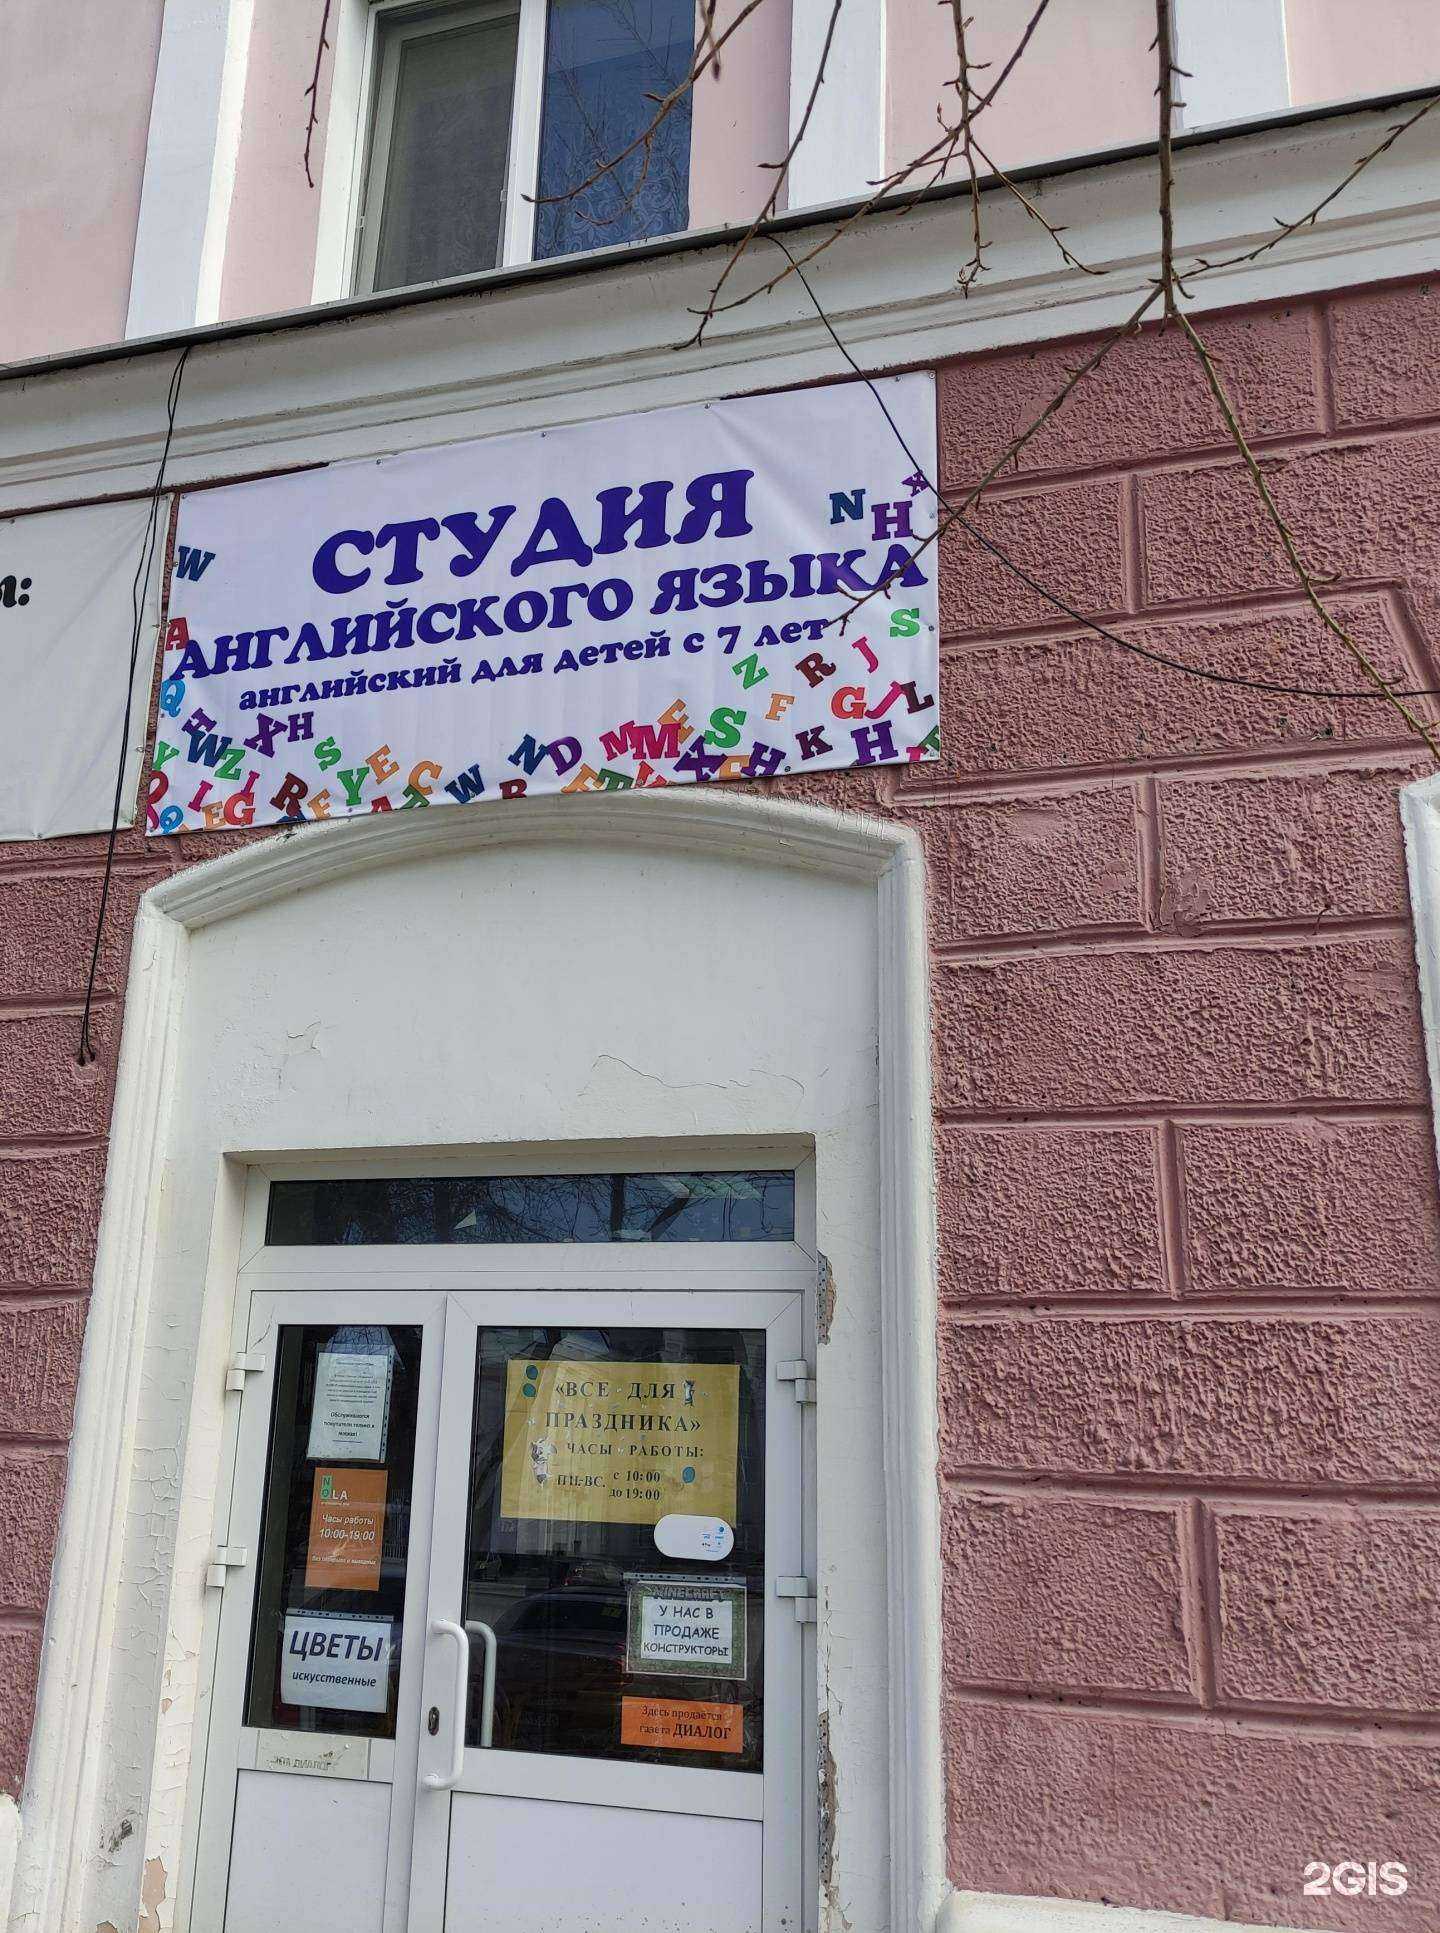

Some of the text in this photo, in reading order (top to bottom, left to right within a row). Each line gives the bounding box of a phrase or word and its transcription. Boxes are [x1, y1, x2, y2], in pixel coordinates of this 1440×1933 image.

[312, 469, 754, 594] СТУДИЯ
[170, 544, 929, 680] АНГЛИЙСКОГО ЯЗЫКА
[239, 618, 829, 710] английский для детей с 7 лет
[555, 1381, 675, 1401] «ВСЕ ДЛЯ
[545, 1412, 701, 1432] ПРАЗДНИКА»
[567, 1442, 704, 1458] ЧАСЫ РАБОТЫ:
[625, 1470, 661, 1482] 10:00
[609, 1487, 661, 1500] до 19:00
[322, 1513, 374, 1526] Часы работы
[320, 1528, 375, 1541] 10:00-19:00
[659, 1605, 714, 1619] У НАС В
[653, 1624, 720, 1640] ПРОДАЖЕ
[289, 1630, 384, 1661] ЦВЕТЫ
[643, 1642, 729, 1657] КОНСТРУКТОРЫ
[292, 1671, 377, 1687] искусственные
[641, 1705, 670, 1717] Здесь
[639, 1723, 732, 1740] газета ДИАЛОГ
